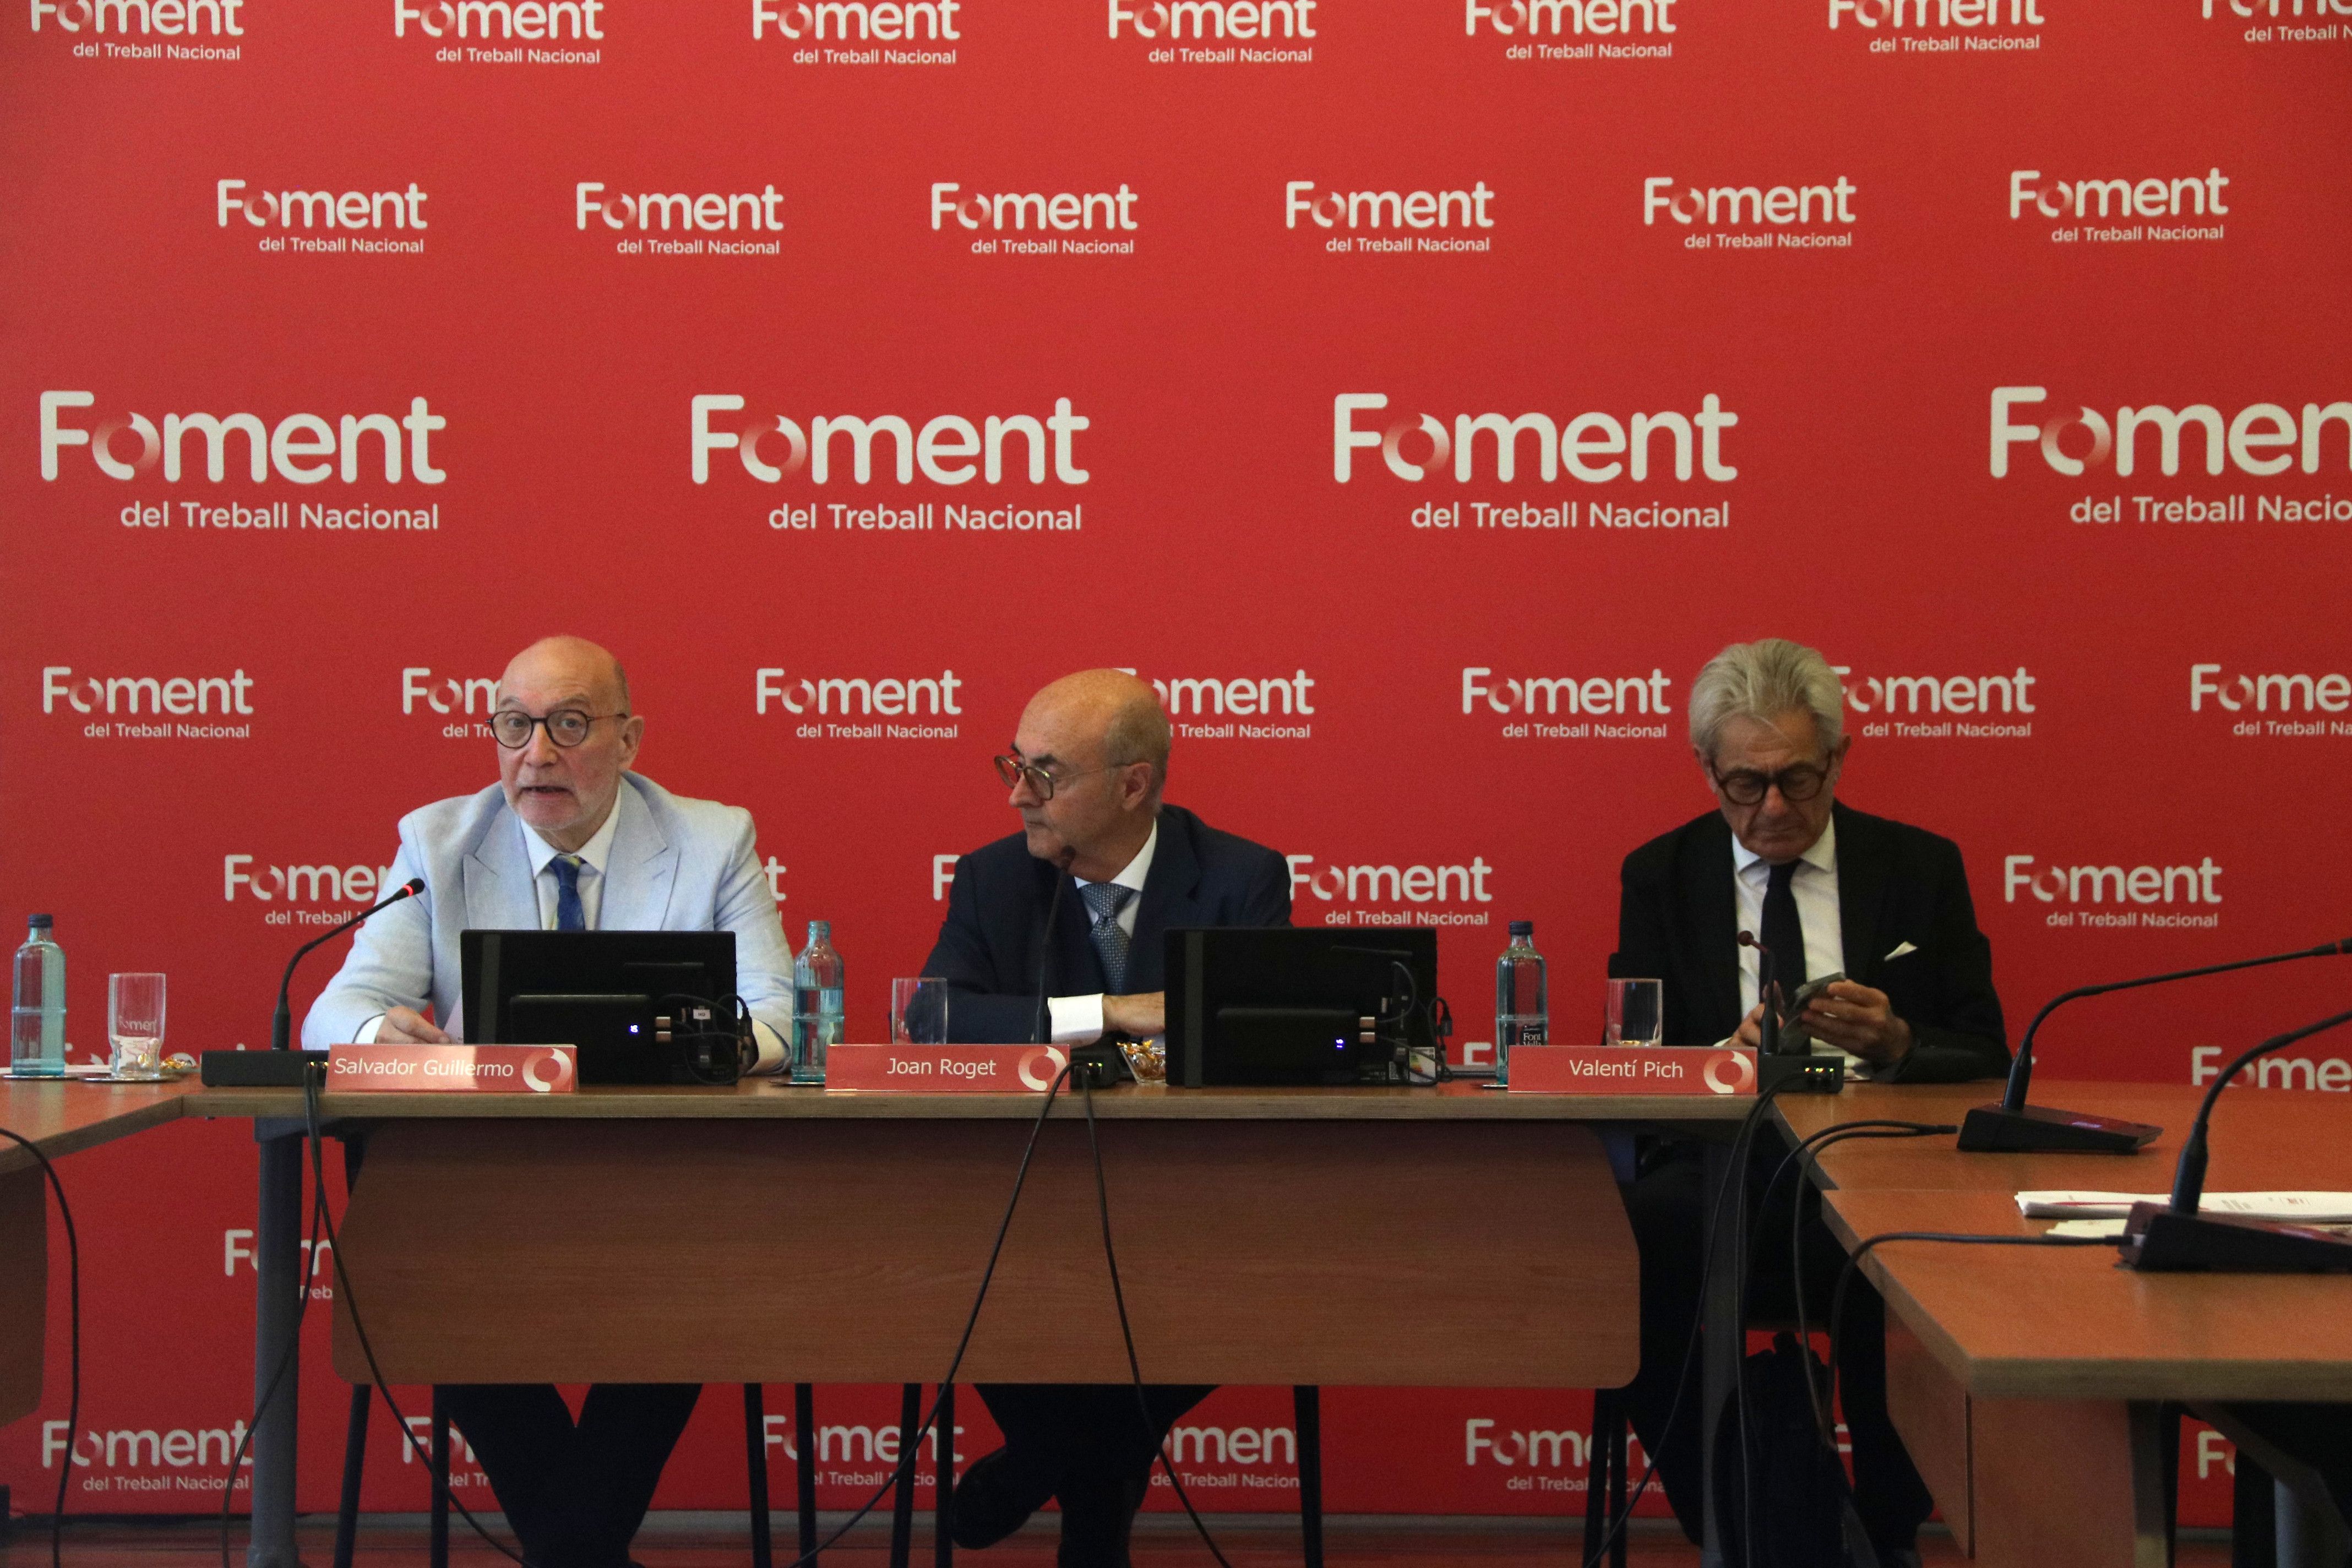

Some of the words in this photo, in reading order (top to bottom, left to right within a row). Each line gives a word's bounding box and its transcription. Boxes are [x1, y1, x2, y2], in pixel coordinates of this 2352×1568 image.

[30, 0, 244, 36] Foment
[395, 0, 604, 40] Foment
[753, 0, 961, 41] Foment
[1108, 0, 1317, 39] Foment
[1466, 0, 1676, 36] Foment
[2244, 27, 2272, 41] del
[2278, 25, 2337, 41] Treball
[73, 42, 99, 57] del
[105, 43, 161, 58] Treball
[167, 45, 240, 60] Nacional
[1506, 45, 1532, 59] del
[1538, 44, 1593, 59] Treball
[1599, 43, 1672, 58] Nacional
[1870, 38, 1896, 52] del
[1902, 36, 1959, 51] Treball
[1965, 35, 2040, 50] Nacional
[436, 47, 461, 62] del
[467, 48, 522, 62] Treball
[528, 49, 600, 64] Nacional
[793, 50, 819, 64] del
[824, 49, 879, 64] Treball
[885, 50, 956, 64] Nacional
[1148, 48, 1174, 62] del
[1180, 48, 1235, 62] Treball
[1240, 48, 1312, 62] Nacional
[1644, 176, 1856, 225] Foment
[2010, 167, 2229, 219] Foment
[217, 179, 428, 230] Foment
[576, 182, 784, 231] Foment
[932, 183, 1139, 231] Foment
[1286, 181, 1494, 229] Foment
[1685, 234, 1710, 248] del
[1717, 233, 1772, 247] Treball
[1778, 233, 1852, 247] Nacional
[2052, 228, 2078, 242] del
[2085, 227, 2142, 241] Treball
[2148, 225, 2224, 240] Nacional
[259, 237, 285, 251] del
[290, 237, 346, 252] Treball
[352, 238, 424, 253] Nacional
[617, 239, 643, 253] del
[648, 239, 703, 254] Treball
[708, 241, 780, 254] Nacional
[972, 239, 997, 253] del
[1002, 239, 1057, 253] Treball
[1063, 240, 1134, 254] Nacional
[1326, 238, 1351, 252] del
[1357, 238, 1412, 252] Treball
[1418, 237, 1489, 252] Nacional
[40, 390, 447, 484] Foment
[692, 394, 1090, 485] Foment
[1334, 393, 1738, 483] Foment
[1990, 386, 2352, 478] Fomen
[121, 500, 169, 527] del
[180, 502, 288, 529] Treball
[301, 503, 438, 530] Nacional
[769, 503, 816, 529] del
[827, 503, 933, 530] Treball
[945, 504, 1081, 530] Nacional
[1411, 502, 1459, 528] del
[1471, 502, 1577, 528] Treball
[1589, 501, 1729, 528] Nacional
[2070, 496, 2120, 523] del
[2132, 495, 2245, 522] Treball
[2258, 494, 2352, 521] Nacio
[43, 666, 254, 715] Foment
[402, 667, 501, 715] Fom
[756, 668, 962, 715] Foment
[1462, 667, 1671, 715] Foment
[2191, 664, 2352, 712] Fome
[84, 723, 110, 737] del
[116, 723, 171, 737] Treball
[177, 724, 249, 738] Nacional
[443, 723, 468, 737] del
[797, 724, 821, 738] del
[827, 724, 881, 738] Treball
[887, 725, 958, 738] Nacional
[1179, 724, 1233, 738] Treball
[1239, 725, 1310, 738] Nacional
[1503, 724, 1528, 737] del
[1533, 723, 1589, 737] Treball
[1594, 725, 1667, 737] Nacional
[1863, 723, 1888, 736] del
[1895, 723, 1951, 736] Treball
[1957, 723, 2030, 737] Nacional
[2233, 722, 2260, 735] del
[2267, 721, 2324, 735] Treball
[225, 854, 390, 901] Fome
[1285, 854, 1492, 902] Foment
[2005, 855, 2222, 903] Foment
[265, 911, 291, 924] del
[295, 911, 352, 925] Treball
[1326, 911, 1351, 924] del
[1356, 911, 1411, 924] Treball
[1417, 912, 1488, 925] Nacional
[2047, 913, 2073, 925] del
[2079, 912, 2136, 926] Treball
[2143, 913, 2218, 927] Nacional
[334, 1058, 416, 1076] Salvador
[423, 1059, 514, 1077] Guillermo
[887, 1058, 933, 1075] Joan
[939, 1058, 997, 1080] Roget
[1570, 1059, 1638, 1077] Valentí
[1643, 1060, 1684, 1079] Pich
[83, 1476, 108, 1491] del
[115, 1476, 170, 1490] Treball
[828, 1472, 883, 1486] Treball
[1183, 1473, 1237, 1487] Treball
[1242, 1474, 1300, 1488] Nacion
[1507, 1476, 1533, 1490] del
[1538, 1477, 1588, 1490] Trebal
